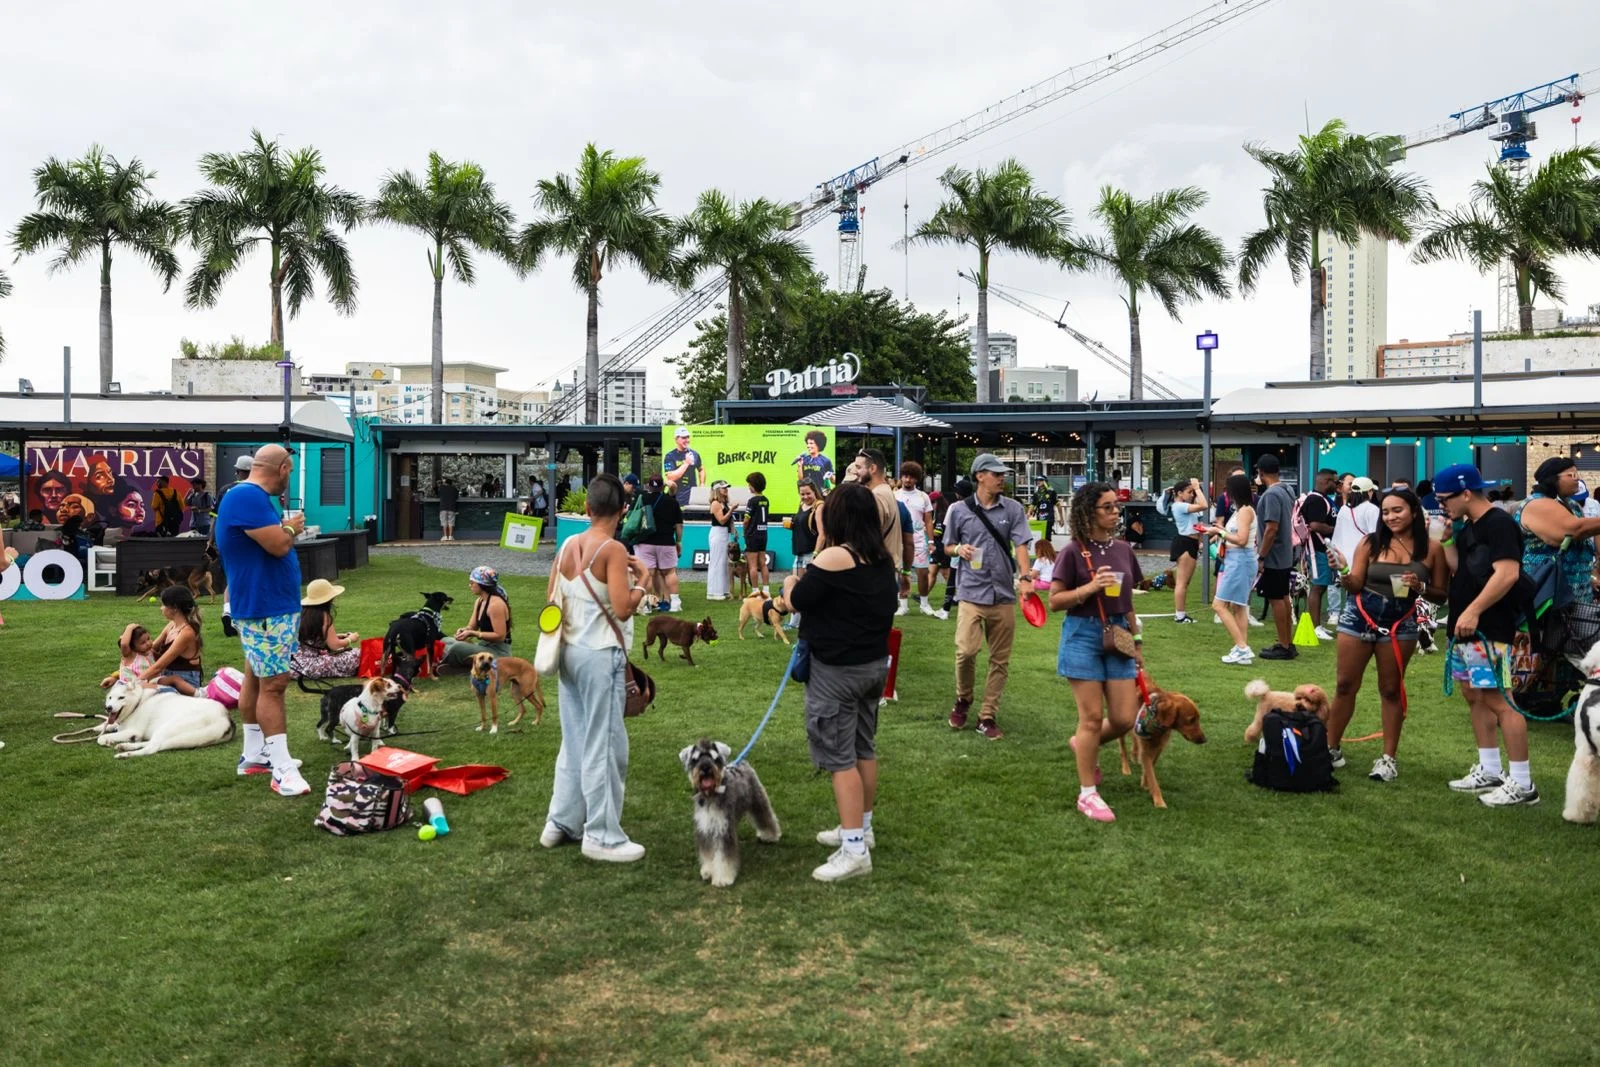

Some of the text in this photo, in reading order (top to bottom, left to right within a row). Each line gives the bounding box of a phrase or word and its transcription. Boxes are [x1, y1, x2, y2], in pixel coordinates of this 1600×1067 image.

[765, 352, 860, 397] Patria
[30, 448, 201, 479] MATRIAS
[717, 451, 747, 465] BARK
[752, 450, 777, 464] PLAY
